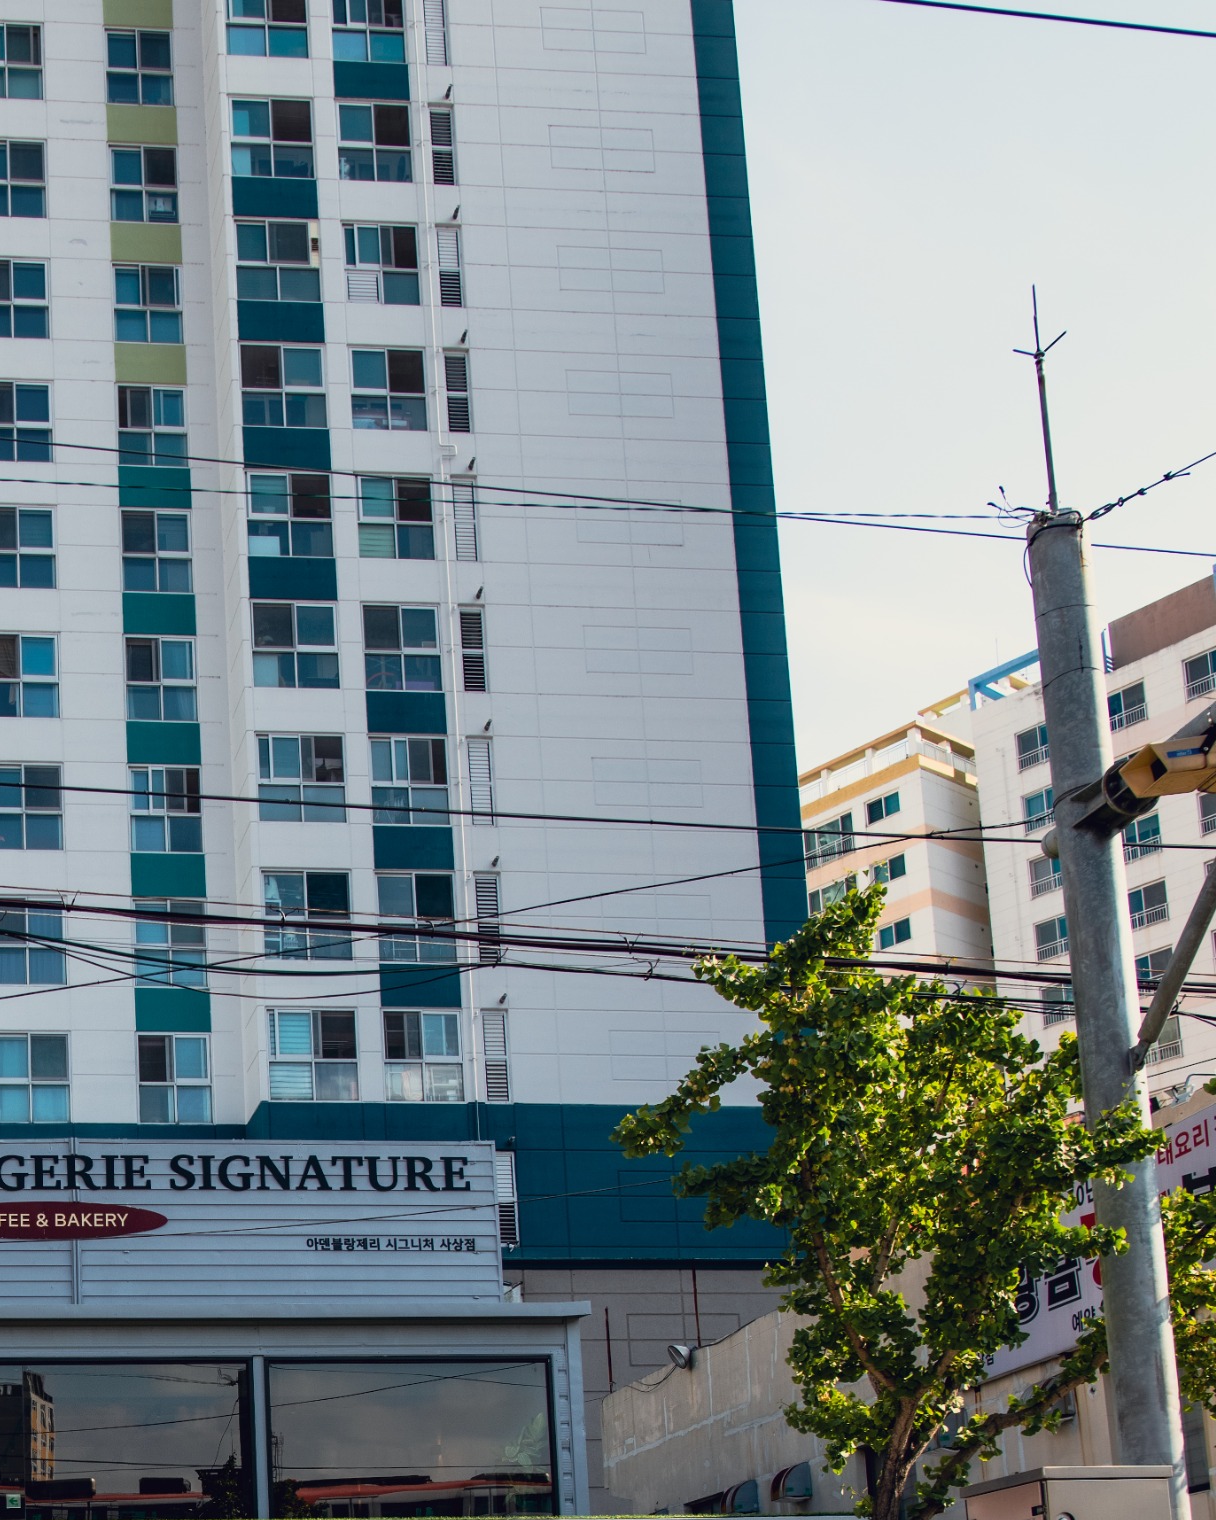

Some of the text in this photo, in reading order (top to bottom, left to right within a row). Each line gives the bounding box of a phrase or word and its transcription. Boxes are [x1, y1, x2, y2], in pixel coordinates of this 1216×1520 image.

[169, 1153, 472, 1192] SIGNATURE
[36, 1213, 49, 1228] &
[54, 1212, 129, 1228] BAKERY
[385, 1237, 435, 1251] 시그니처
[439, 1237, 476, 1251] 사상점
